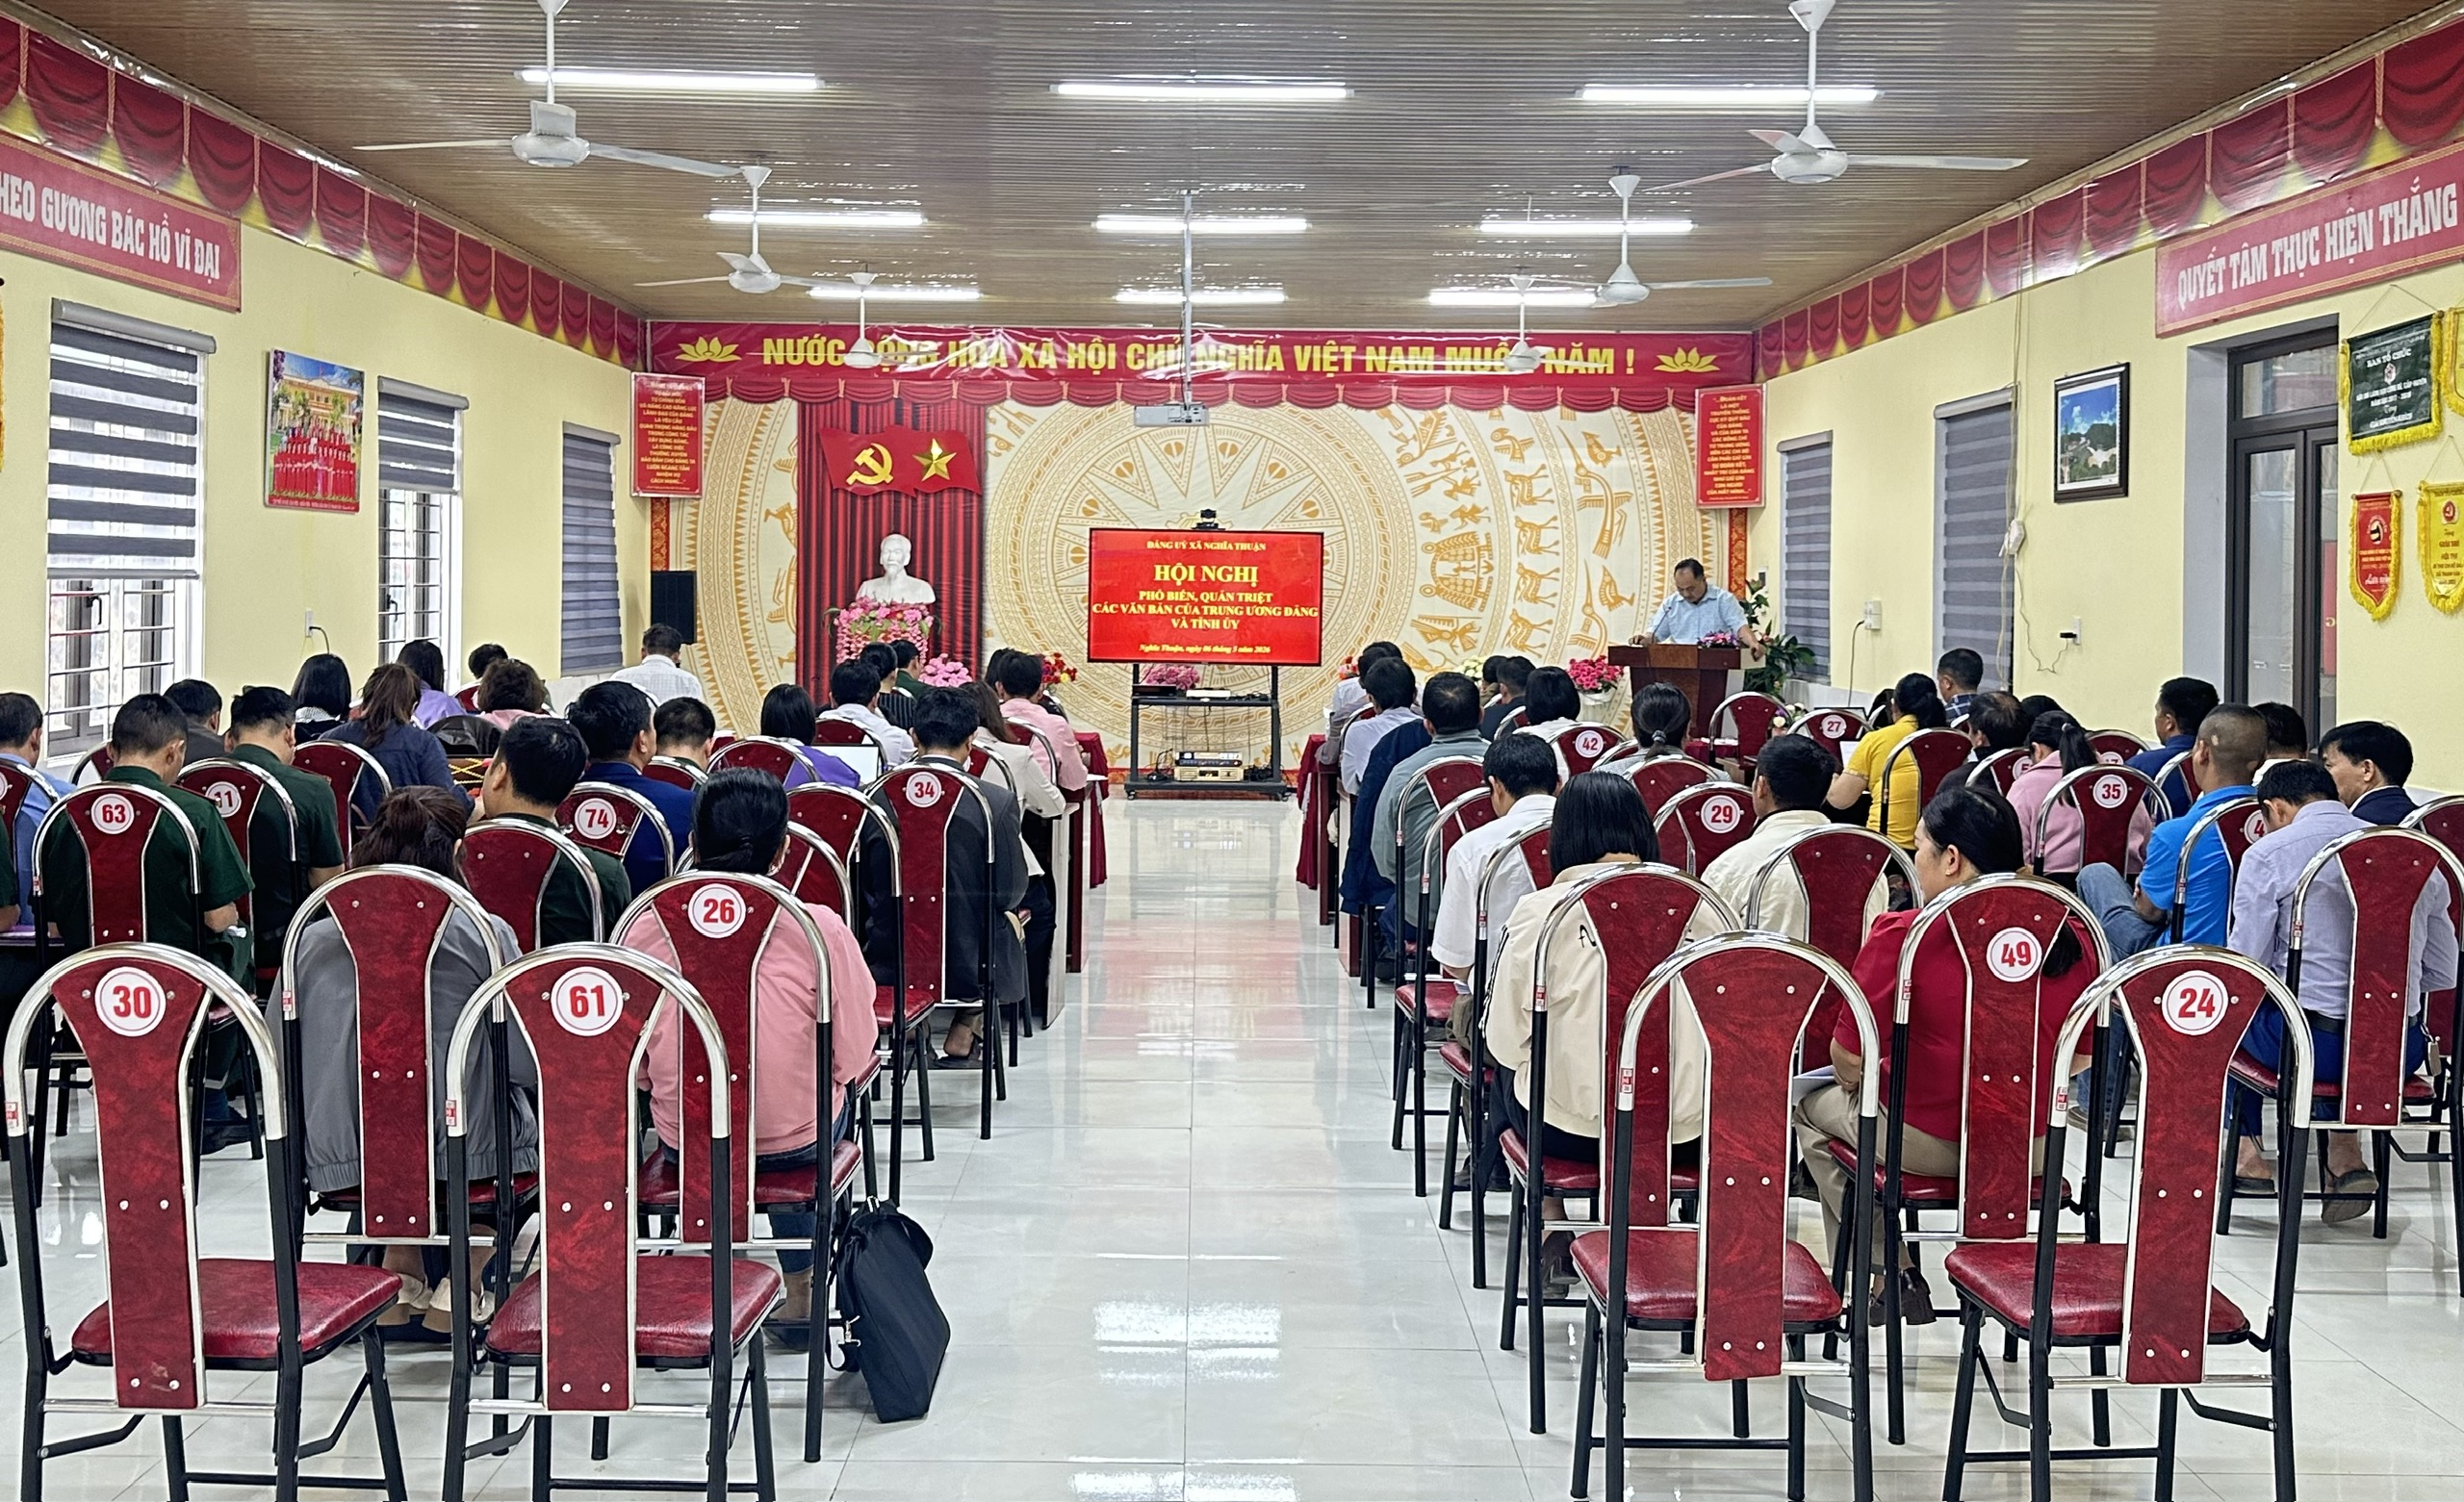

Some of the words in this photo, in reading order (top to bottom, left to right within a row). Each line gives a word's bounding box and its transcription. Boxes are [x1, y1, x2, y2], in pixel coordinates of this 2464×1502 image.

[0, 171, 36, 222] HEO
[41, 187, 107, 245] GƯƠNG
[111, 208, 144, 257] BÁC
[148, 213, 171, 265] HỒ
[174, 228, 191, 270] VĨ
[194, 239, 220, 284] ĐẠI
[2177, 246, 2226, 311] QUYẾT
[2229, 242, 2268, 290] TÂM
[2272, 226, 2320, 277] THỰC
[2324, 207, 2374, 264] HIỆN
[2379, 176, 2457, 246] THẮNG
[763, 333, 845, 366] NƯỚC
[866, 334, 939, 372] ỘNG
[1017, 337, 1058, 369] XÃ
[1067, 336, 1116, 375] HỘI
[1195, 340, 1285, 371] NGHĨA
[1294, 341, 1356, 377] VIỆT
[1365, 345, 1434, 372] NAM
[1445, 342, 1511, 372] MUÔ
[1544, 342, 1615, 374] NĂM
[1627, 348, 1634, 374] !
[1189, 540, 1202, 550] XÃ
[1203, 540, 1233, 550] NGHĨA
[1234, 542, 1267, 552] THUẬN
[1154, 562, 1196, 586] HỘI
[1200, 565, 1259, 588] NGHỊ
[1167, 589, 1198, 603] BIẾN,
[1237, 591, 1273, 604] TRIỆT
[1092, 601, 1118, 614] CÁC
[1120, 602, 1145, 615] VĂN
[1174, 602, 1200, 616] CỦA
[1202, 606, 1245, 616] TRUNG
[1245, 606, 1282, 617] ƯƠNG
[1171, 618, 1189, 628] VÀ
[1827, 721, 1841, 732] 27
[1582, 737, 1598, 751] 42
[914, 780, 934, 799] 34
[2102, 783, 2121, 800] 35
[102, 804, 126, 824] 63
[584, 807, 608, 828] 74
[1710, 805, 1733, 825] 29
[703, 897, 735, 924] 26
[2001, 941, 2033, 968] 49
[113, 985, 152, 1019] 30
[569, 984, 605, 1017] 61
[2178, 987, 2216, 1019] 24
